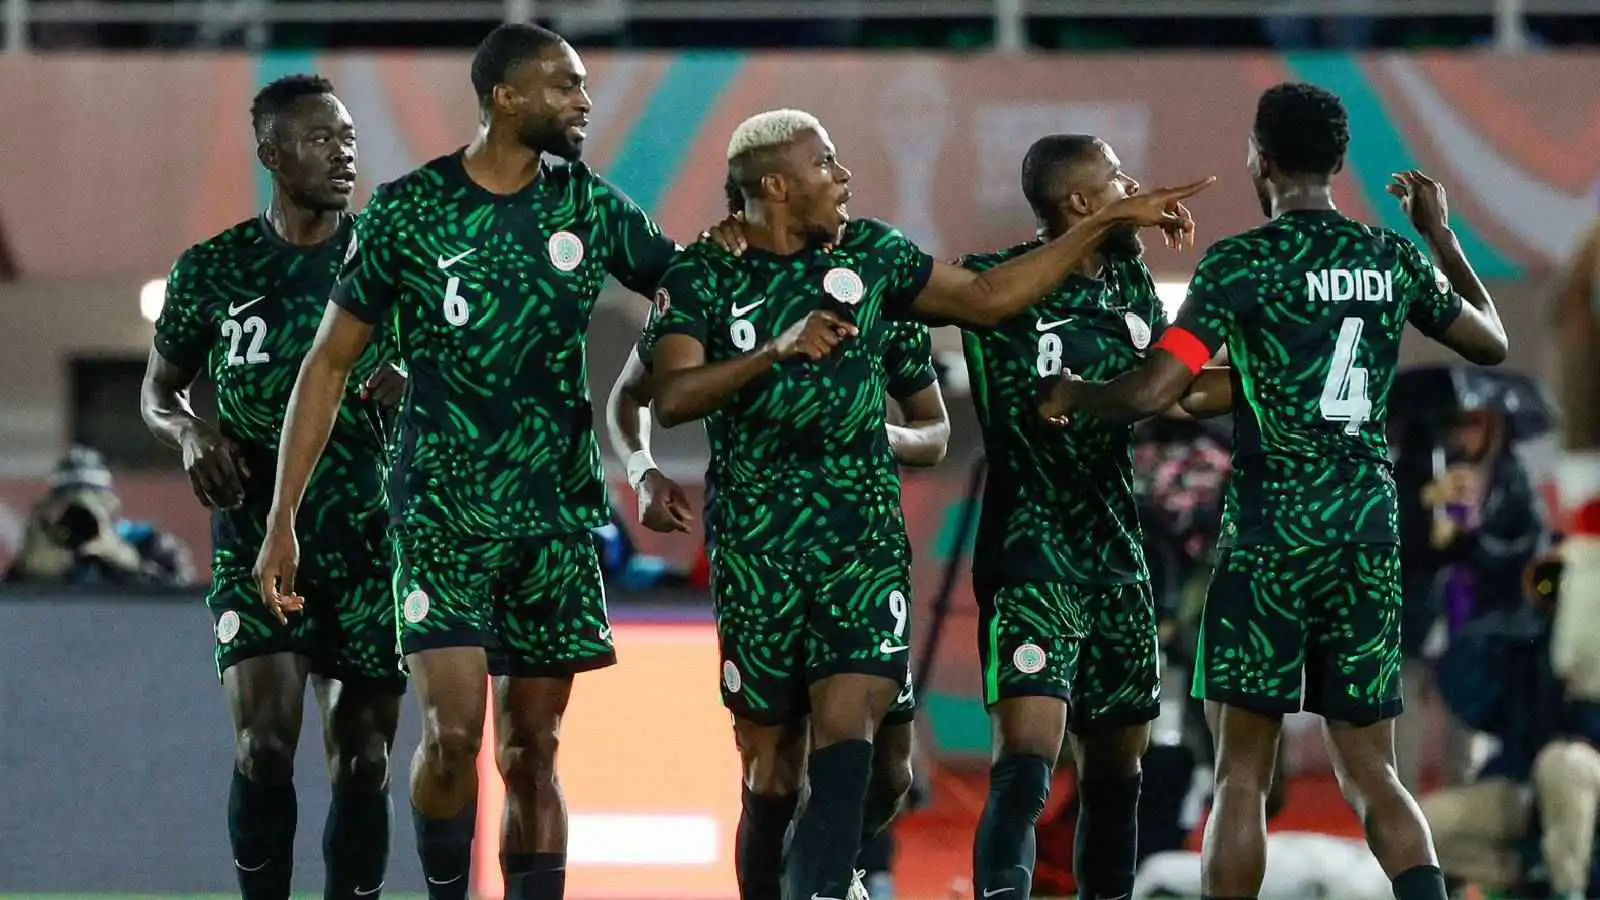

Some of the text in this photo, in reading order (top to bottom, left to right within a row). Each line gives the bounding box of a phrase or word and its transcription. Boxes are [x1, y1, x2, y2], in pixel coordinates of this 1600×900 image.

[443, 276, 470, 326] 6
[1306, 268, 1393, 301] NDIDI
[221, 316, 269, 366] 22
[730, 319, 756, 352] 9
[1037, 333, 1063, 378] 8
[1319, 317, 1372, 436] 4
[889, 590, 907, 638] 9
